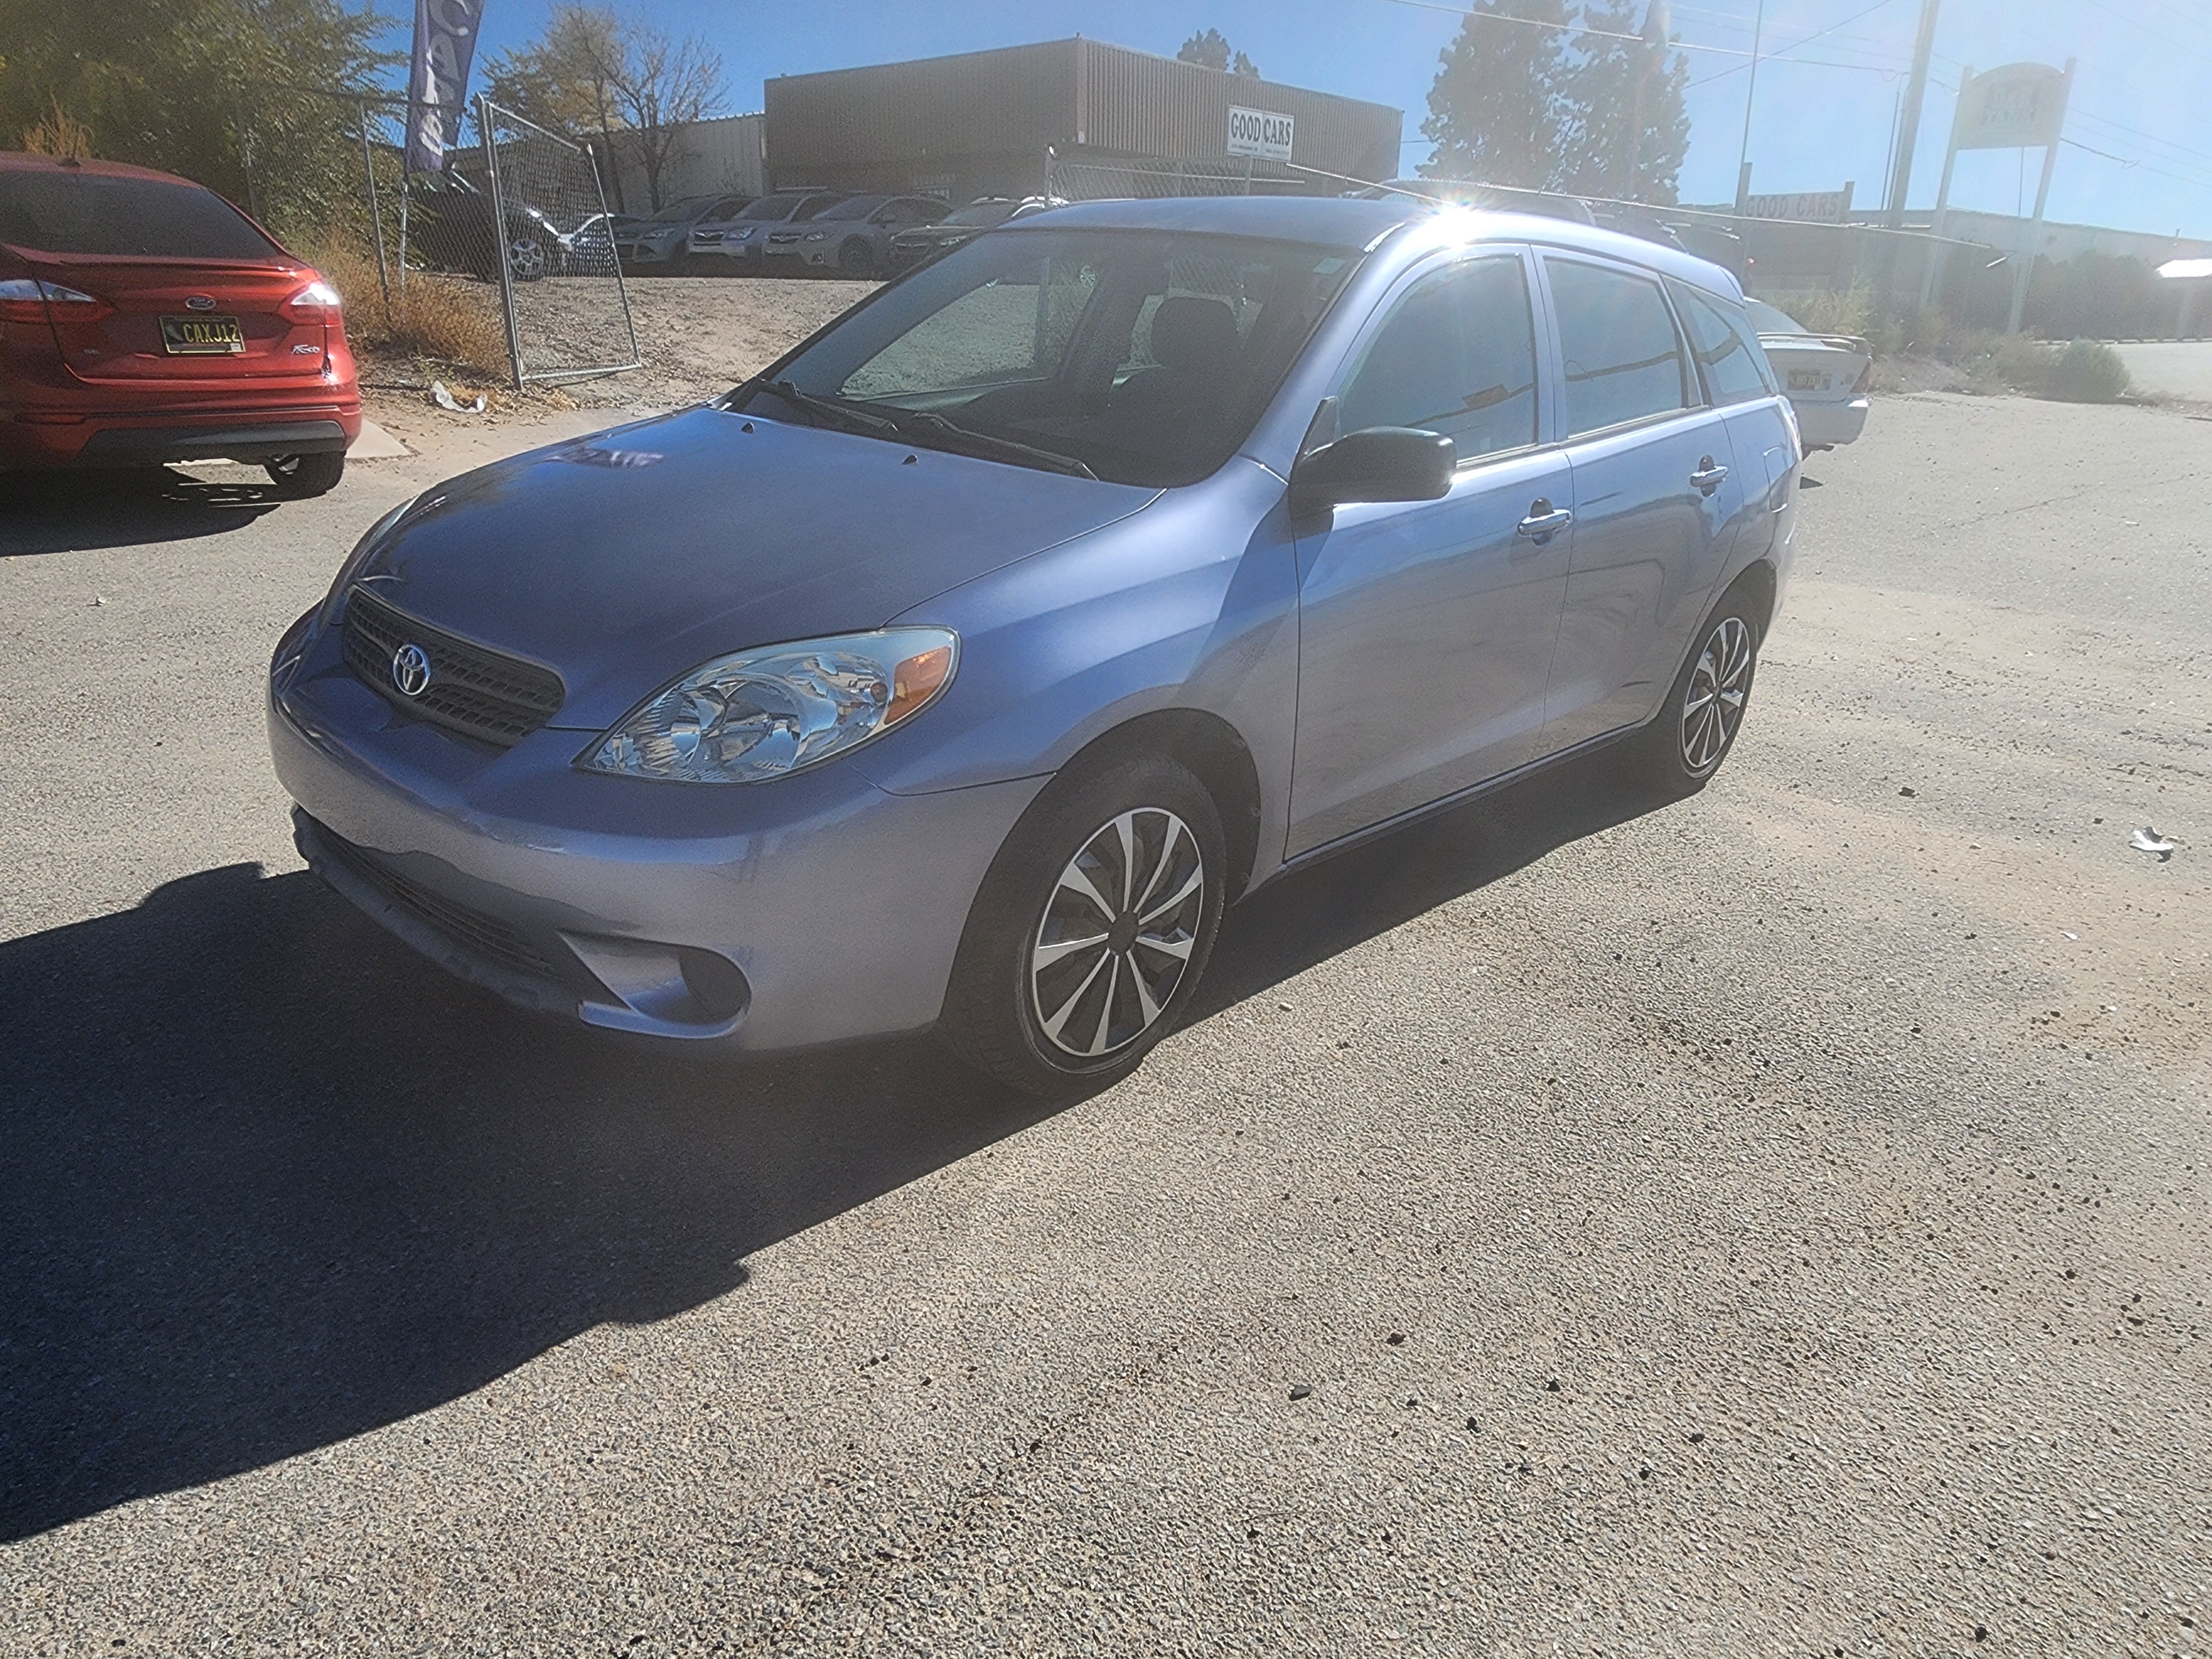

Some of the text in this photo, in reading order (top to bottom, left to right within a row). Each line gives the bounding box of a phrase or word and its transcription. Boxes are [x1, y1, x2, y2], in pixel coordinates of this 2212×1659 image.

[1231, 112, 1291, 147] GOOD CARS
[1745, 194, 1839, 218] GOOD CARS
[183, 324, 241, 342] CAXJ12
